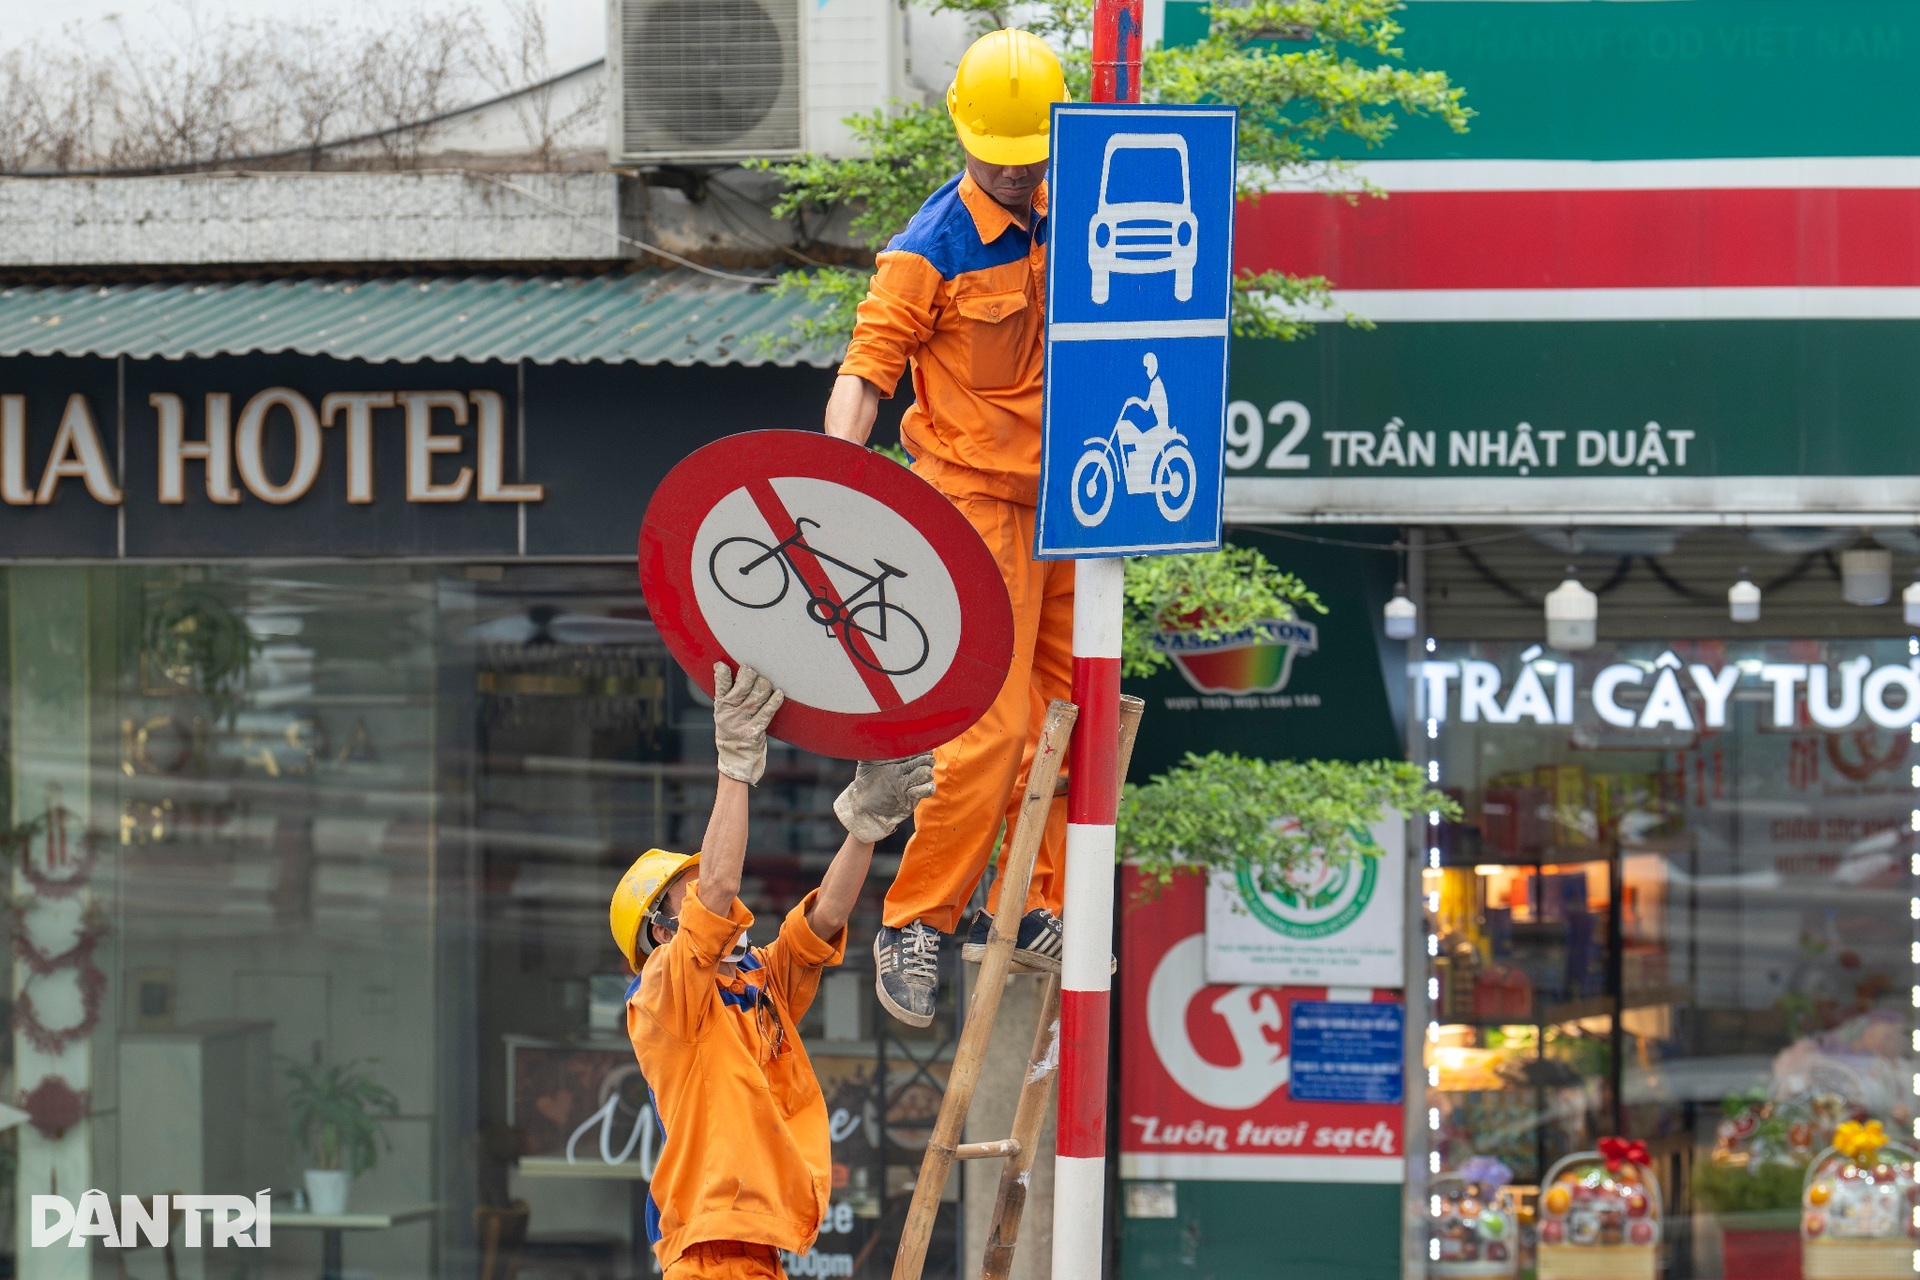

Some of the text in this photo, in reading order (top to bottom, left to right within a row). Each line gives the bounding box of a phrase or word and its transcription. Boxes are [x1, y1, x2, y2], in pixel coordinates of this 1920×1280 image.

[149, 387, 544, 504] HOTEL
[1323, 417, 1436, 467] TRẦN
[1449, 421, 1566, 476] NHẬT
[1577, 421, 1696, 475] DUẬT
[1411, 645, 1574, 724] TRÁI
[1592, 650, 1740, 731] CÂY
[1130, 1114, 1396, 1154] Luôn tươi sạch
